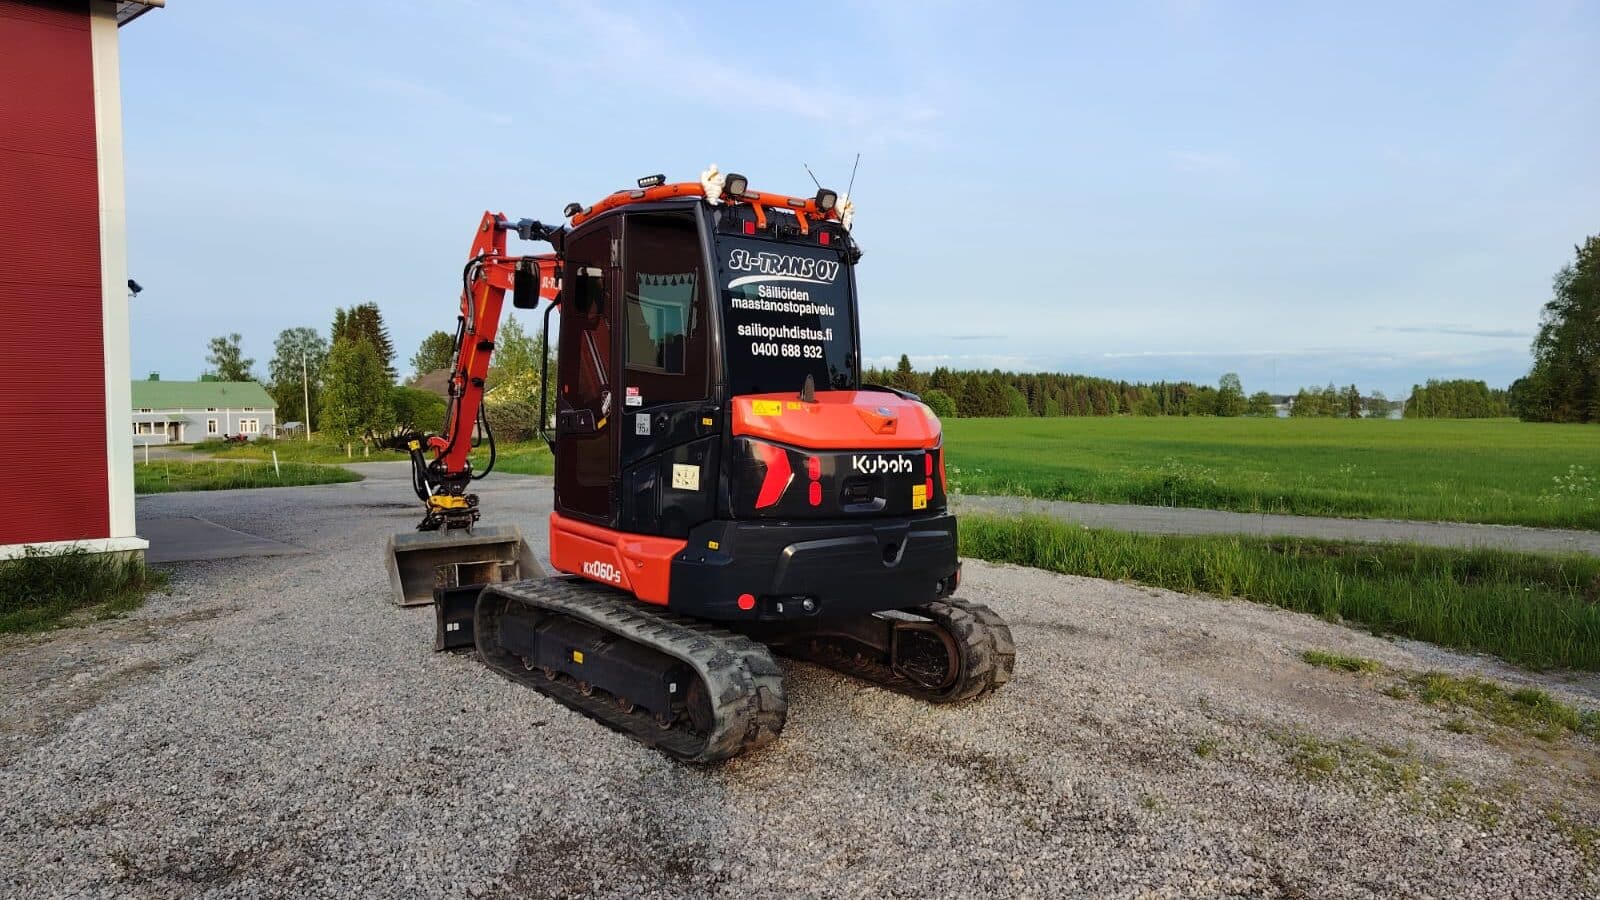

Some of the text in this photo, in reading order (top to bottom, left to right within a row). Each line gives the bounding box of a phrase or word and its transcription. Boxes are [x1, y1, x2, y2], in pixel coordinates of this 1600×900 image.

[729, 249, 839, 281] SL-TRANS OY
[758, 285, 809, 301] Säiliöiden
[732, 298, 835, 316] maastanostopalvelu
[737, 323, 833, 341] sailiopuhdistus.fi
[751, 342, 823, 359] 0400 688 932
[852, 455, 913, 474] Kubota
